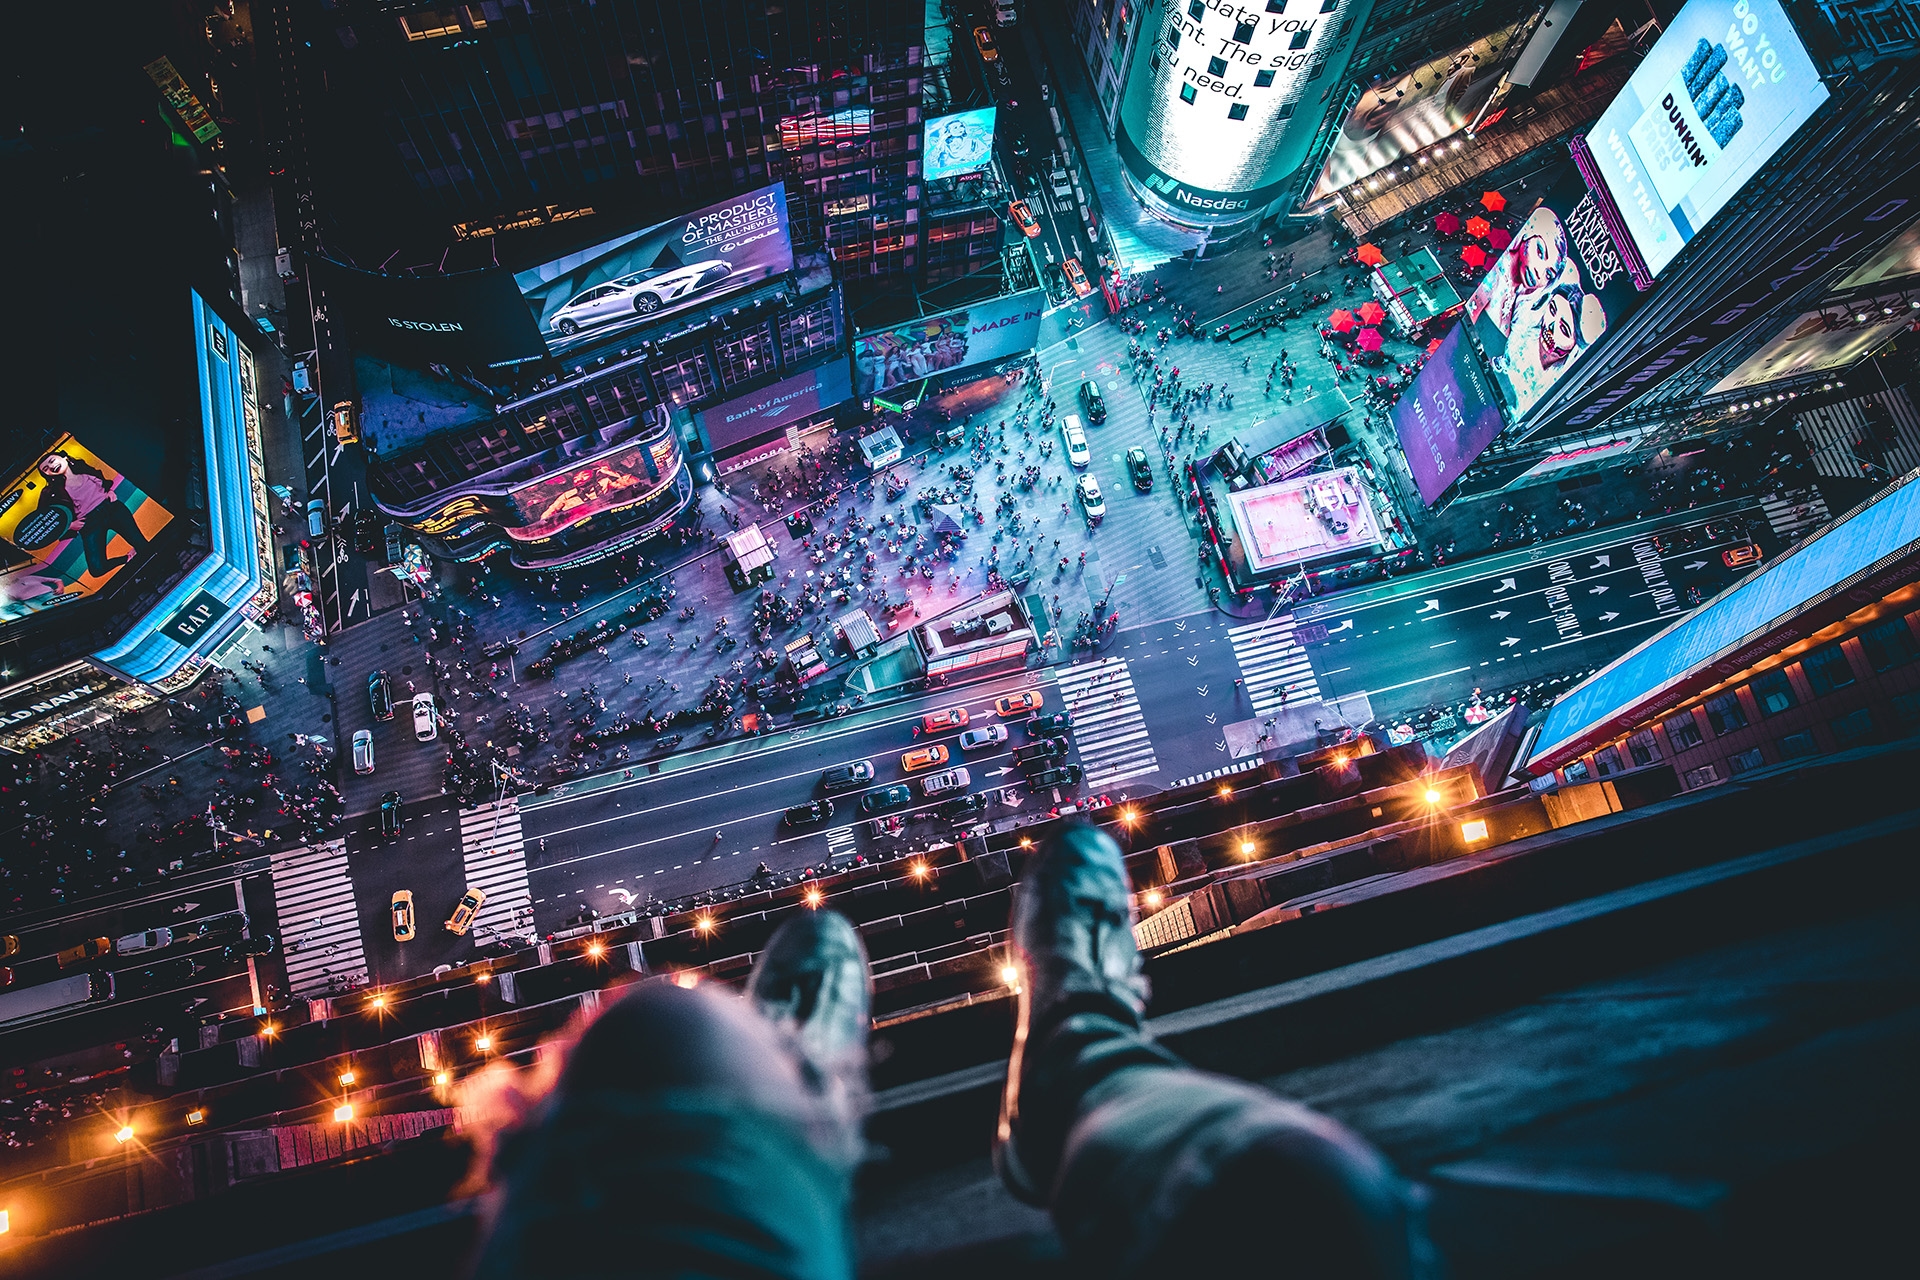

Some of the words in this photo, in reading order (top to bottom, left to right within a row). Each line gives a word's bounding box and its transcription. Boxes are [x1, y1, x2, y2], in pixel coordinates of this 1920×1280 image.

[1268, 18, 1318, 36] you
[1733, 0, 1759, 36] DO
[1754, 32, 1788, 85] YOU
[1151, 30, 1180, 68] you
[1183, 65, 1244, 100] need.
[1219, 37, 1263, 66] The
[1725, 22, 1766, 90] WANT
[1640, 118, 1672, 172] FRIES
[1650, 105, 1691, 173] DONUT
[1661, 91, 1709, 168] DUNKIN'
[1607, 127, 1638, 184] WITH
[685, 221, 698, 233] A
[699, 191, 776, 228] PRODUCT
[1175, 188, 1250, 211] Nasdaq
[682, 228, 704, 244] OF
[707, 202, 777, 236] MASTERY
[704, 235, 723, 246] THE
[724, 219, 765, 240] ALL-NEW
[767, 214, 779, 224] ES
[736, 227, 780, 247] LEXUS
[1576, 193, 1624, 281] FANTASY
[1564, 207, 1609, 290] MAKERS
[388, 317, 403, 328] IS
[402, 320, 464, 332] STOLEN
[971, 314, 1021, 335] MADE
[1023, 308, 1042, 321] IN
[1565, 386, 1636, 426] CALL
[1625, 334, 1708, 383] DUTY
[1710, 231, 1863, 325] BLACK
[951, 373, 983, 386] CITIZEN
[725, 406, 757, 424] Bank
[758, 400, 772, 411] of
[772, 381, 823, 406] America
[1432, 390, 1458, 443] LOVED
[1441, 383, 1466, 429] MOST
[1412, 397, 1447, 476] WIRELESS.
[1431, 416, 1443, 436] IN
[1, 492, 20, 509] NAVY
[610, 503, 634, 514] NOW
[530, 537, 551, 545] AND
[604, 545, 618, 555] has
[619, 537, 636, 547] died
[1631, 541, 1662, 564] ONLY
[1548, 560, 1577, 583] ONLY
[1640, 562, 1669, 588] ONLY
[1869, 566, 1913, 593] THOMSON
[1651, 587, 1681, 615] ONLY
[177, 603, 213, 636] GAP
[1553, 612, 1583, 640] ONLY
[1730, 643, 1768, 666] THOMSON
[1763, 628, 1799, 653] REUTERS
[30, 684, 94, 713] NAVY
[826, 827, 858, 858] ONLY
